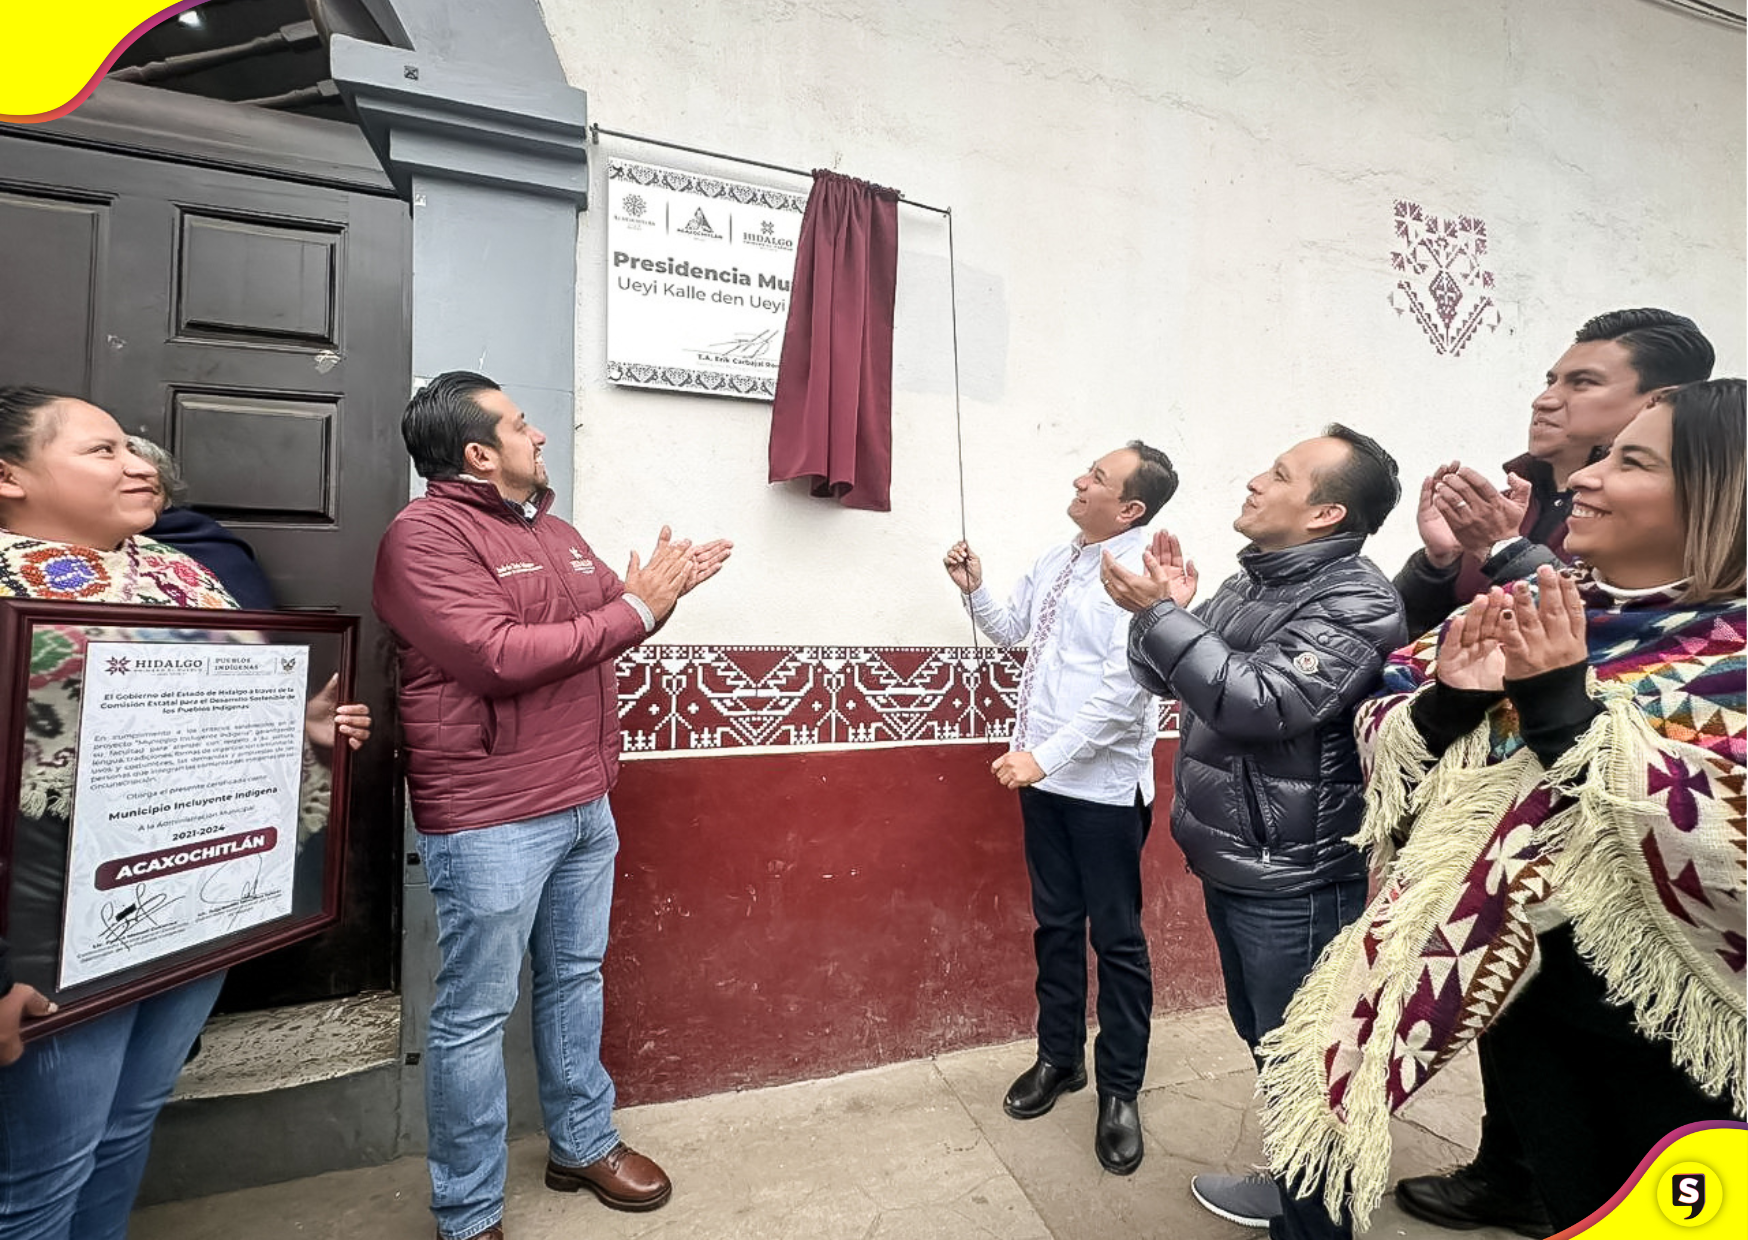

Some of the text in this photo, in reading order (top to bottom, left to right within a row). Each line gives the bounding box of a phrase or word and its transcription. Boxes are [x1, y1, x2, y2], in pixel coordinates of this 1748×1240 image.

[743, 231, 793, 247] HIDALGO
[613, 251, 790, 292] Presidencia Mu
[617, 276, 786, 314] Ueyi Kalle den Ueyi
[135, 659, 202, 668] HIDALGO
[116, 693, 158, 701] Gobierno
[176, 690, 205, 698] Estado
[218, 688, 247, 697] Hidalgo
[100, 701, 145, 709] Comisión
[147, 699, 177, 707] Estatal
[177, 705, 211, 713] Pueblos
[109, 803, 171, 821] Municipio
[174, 795, 232, 810] Incluyente
[172, 824, 226, 841] 2021-2024
[115, 835, 265, 880] ACAXOCHITLÁN
